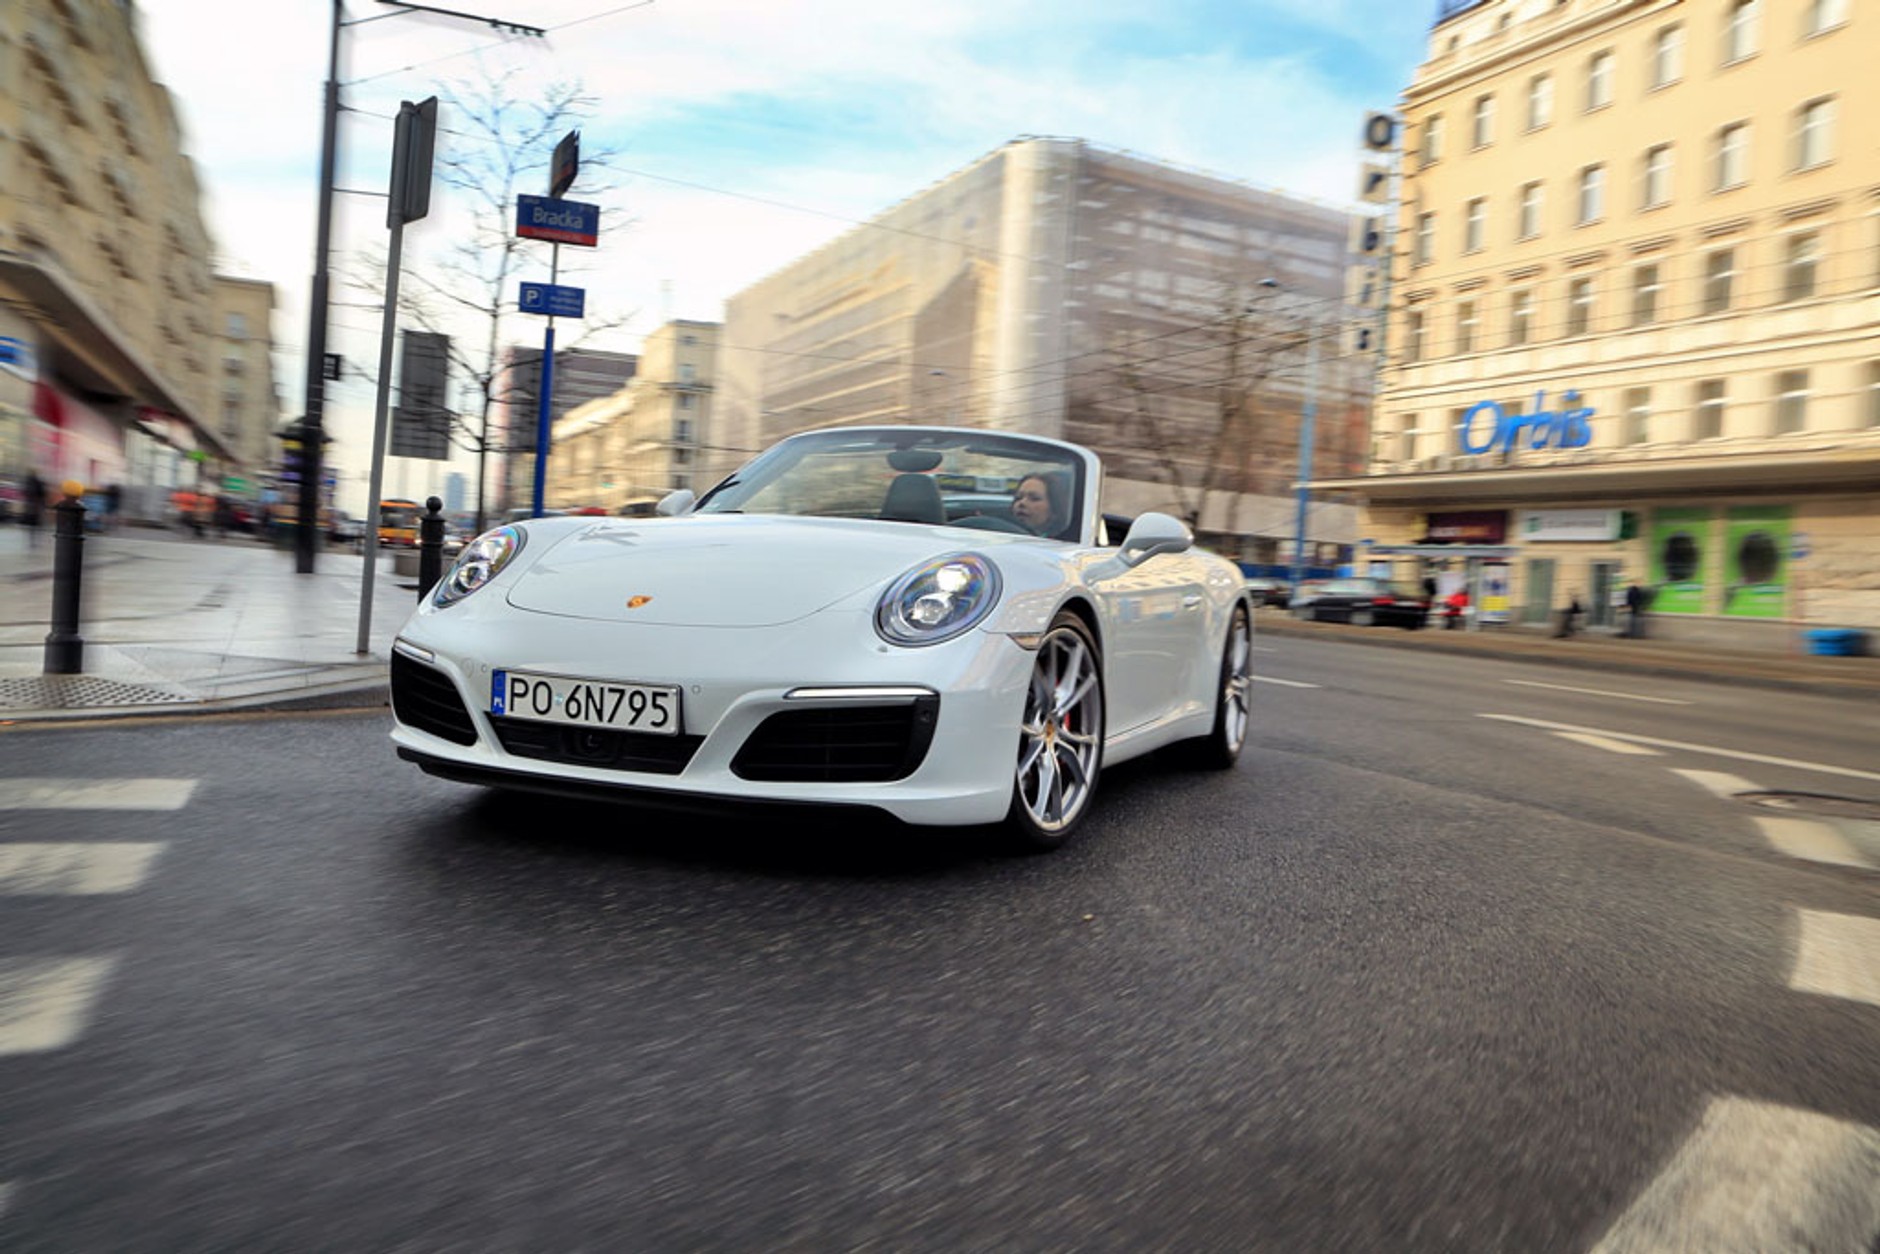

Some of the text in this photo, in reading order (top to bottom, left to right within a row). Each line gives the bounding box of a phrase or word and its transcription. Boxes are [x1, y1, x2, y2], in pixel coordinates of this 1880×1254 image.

[533, 206, 583, 229] Bracka
[526, 289, 539, 305] P
[1460, 389, 1595, 454] Orbis
[510, 677, 668, 727] PO 6N795
